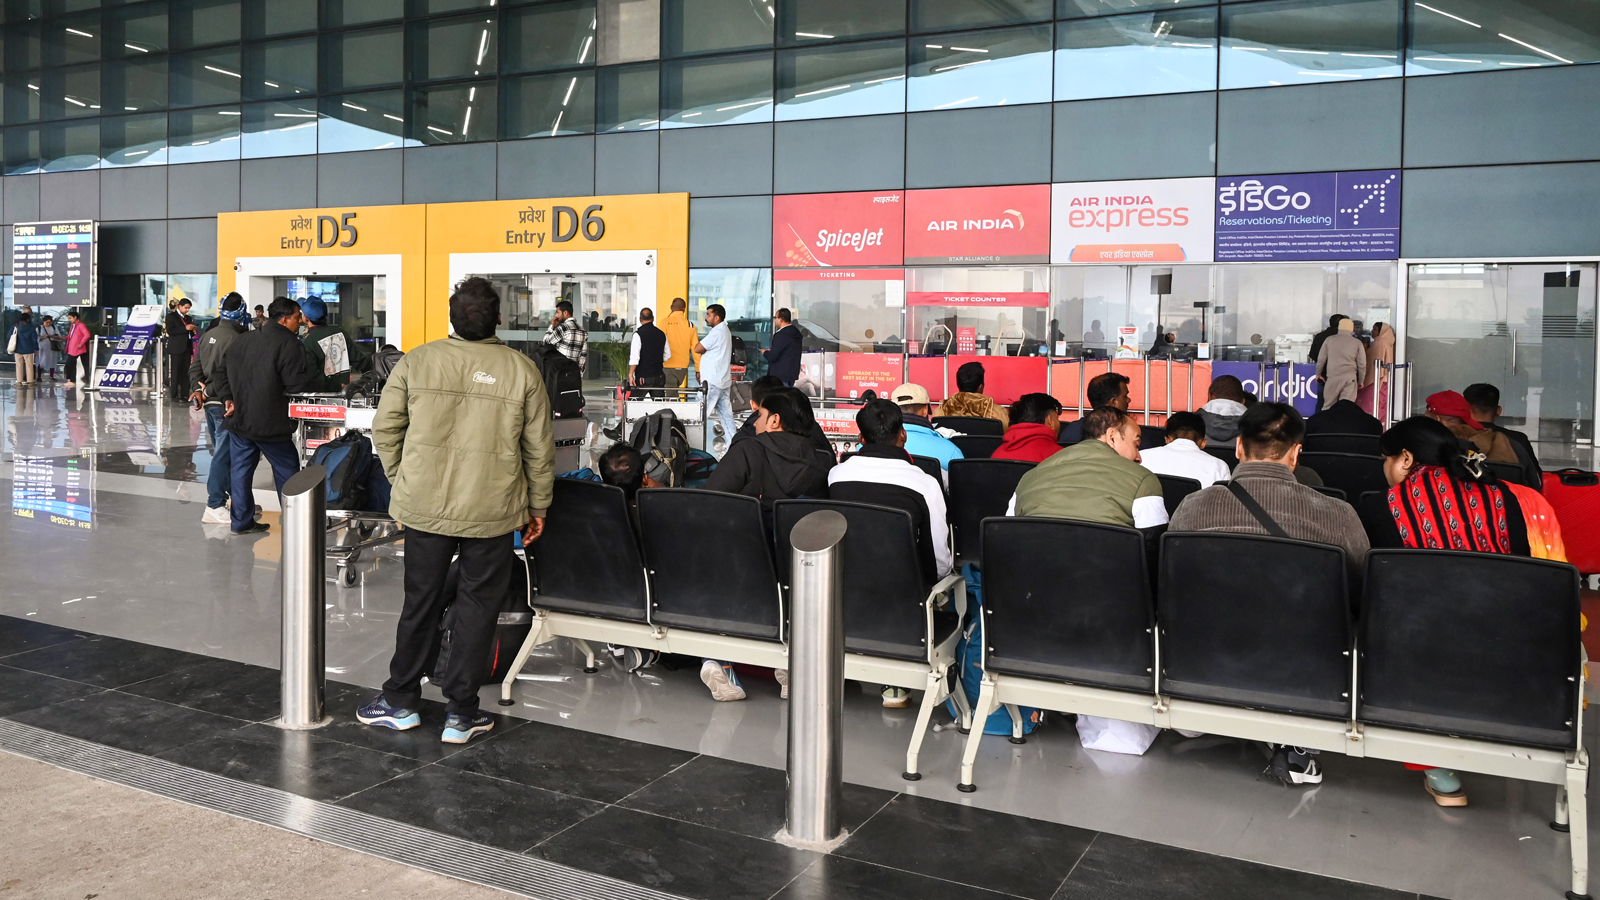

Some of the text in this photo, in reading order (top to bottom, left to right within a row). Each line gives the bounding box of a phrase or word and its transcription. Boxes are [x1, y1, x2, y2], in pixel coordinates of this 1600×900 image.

[1070, 195, 1153, 207] AIR INDIA
[290, 215, 313, 231] प्रवेश
[518, 206, 546, 224] प्रवेश
[552, 204, 606, 243] D6
[1068, 207, 1189, 233] express
[1219, 214, 1332, 226] Reservations/Ticketing
[317, 212, 358, 249] D5
[926, 218, 1014, 231] AIR INDIA
[281, 237, 313, 253] Entry
[506, 229, 546, 249] Entry
[816, 227, 884, 253] SpiceJet
[1100, 250, 1113, 259] एयर
[1114, 249, 1130, 259] इंडिया
